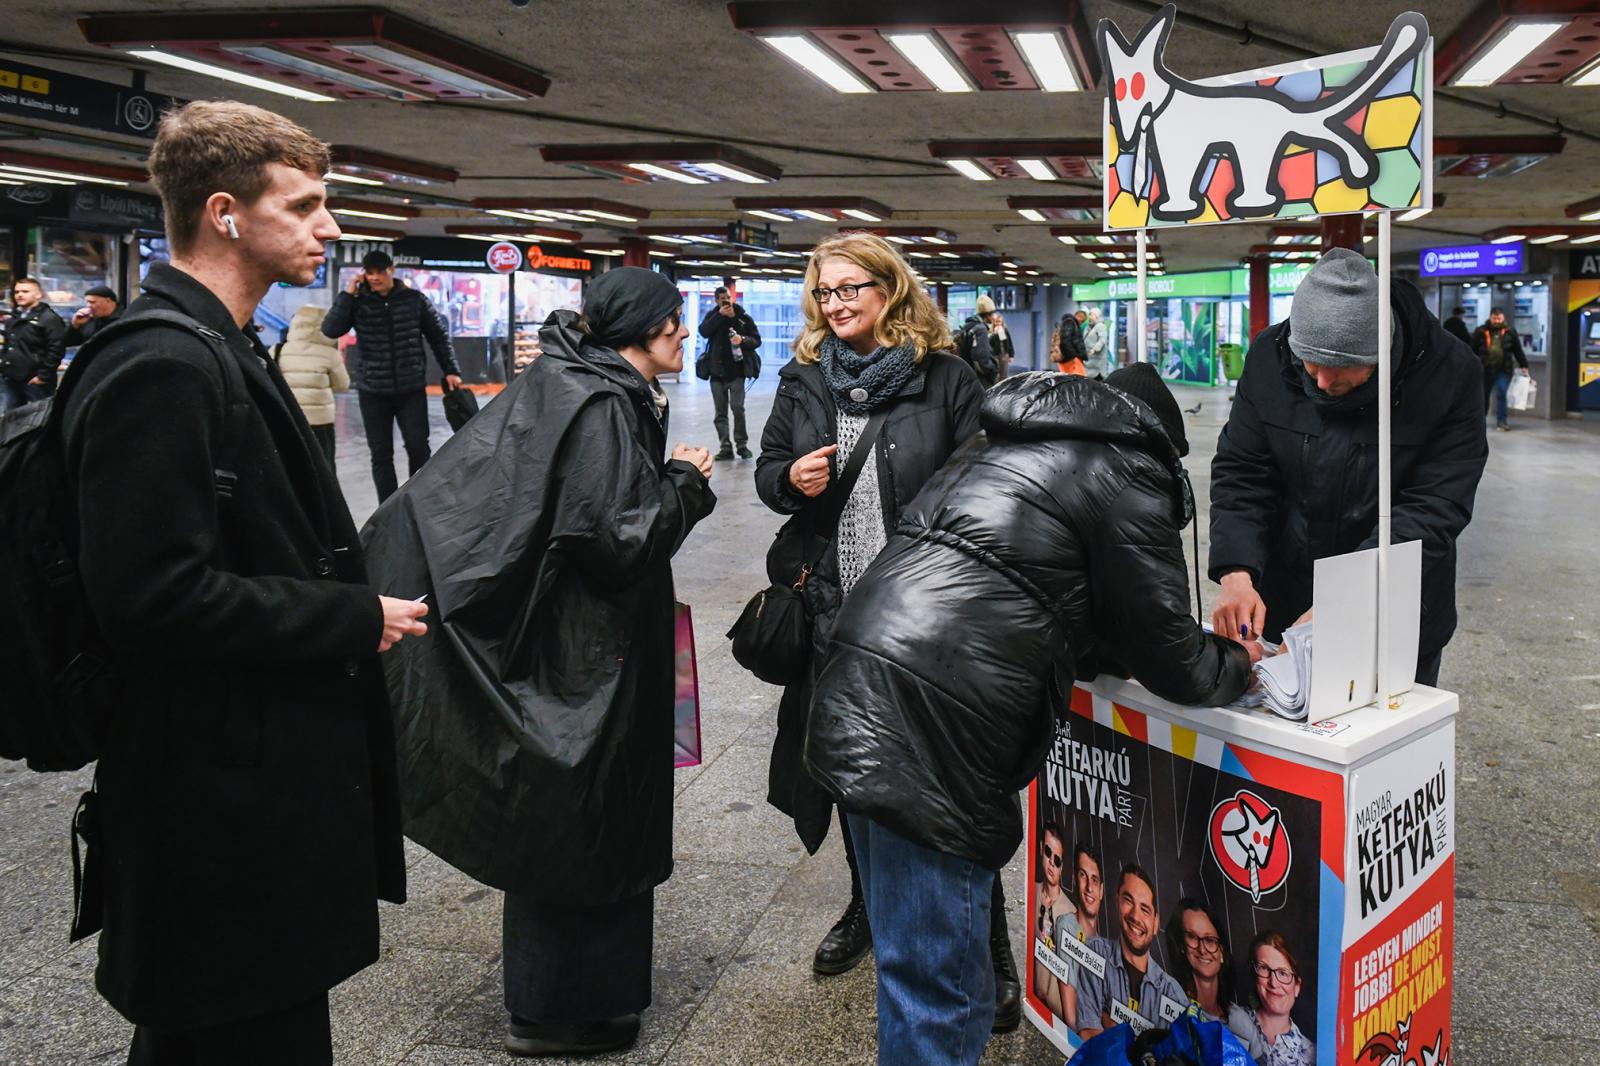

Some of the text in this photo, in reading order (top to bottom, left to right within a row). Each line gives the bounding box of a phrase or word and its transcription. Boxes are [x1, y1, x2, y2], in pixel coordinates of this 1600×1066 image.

[32, 80, 40, 89] 6
[69, 106, 79, 116] M
[393, 254, 421, 266] pizza
[1046, 760, 1116, 823] KUTYA
[1116, 785, 1133, 828] PÁRT
[1356, 790, 1392, 833] MAGYAR
[1357, 761, 1446, 871] KÉTFARKÚ
[1434, 807, 1447, 853] PÁRT
[1359, 820, 1435, 920] KUTYA
[1064, 937, 1103, 974] Sándor Balázs
[1354, 900, 1443, 988] LEGYEN MINDEN
[1352, 928, 1442, 1018] JOBB! DE MOST
[1114, 1005, 1132, 1023] Nagy
[1165, 1003, 1176, 1019] Dr.
[1353, 953, 1447, 1060] KOMOLYAN.
